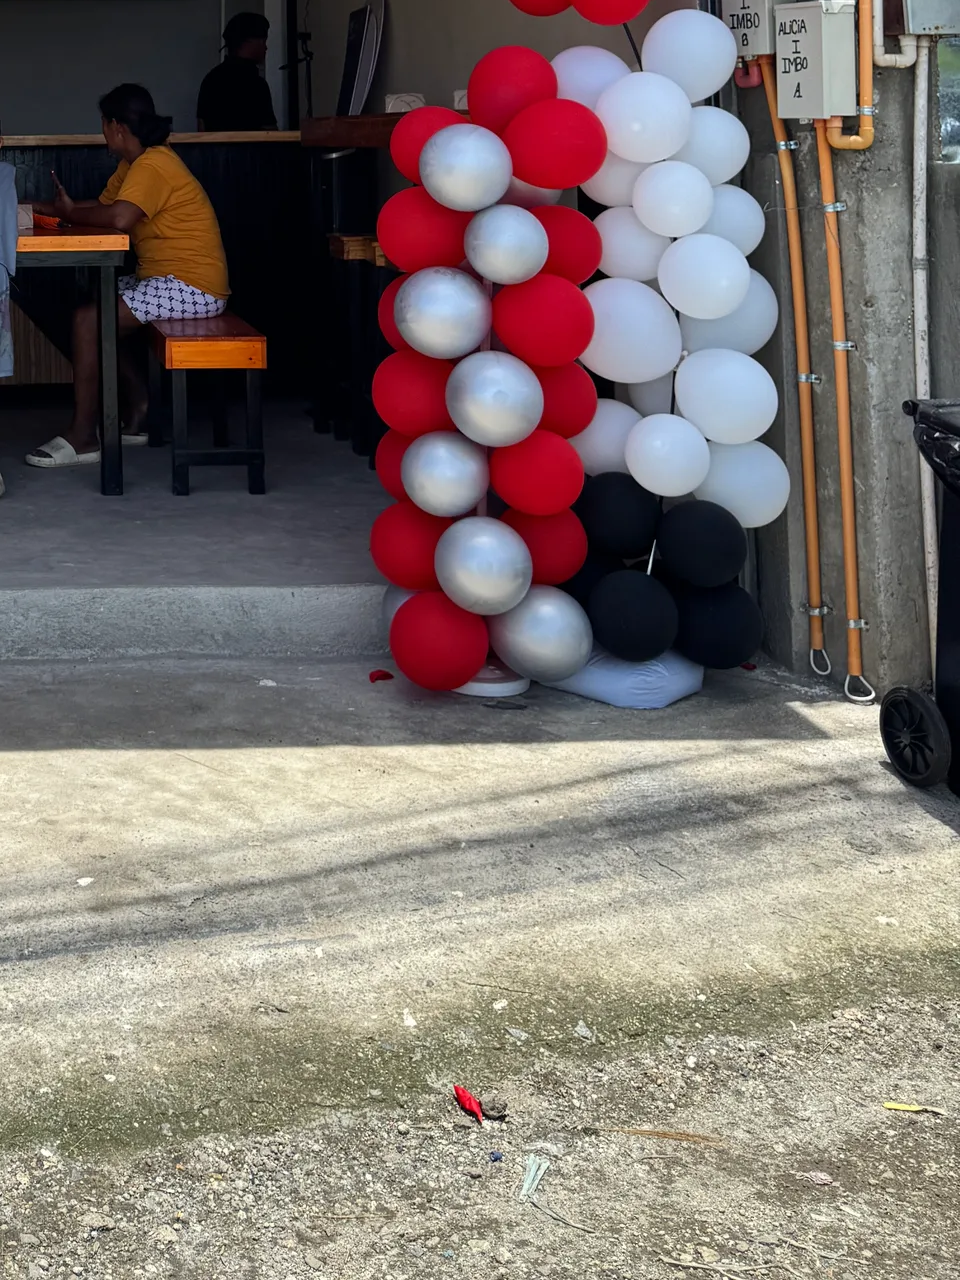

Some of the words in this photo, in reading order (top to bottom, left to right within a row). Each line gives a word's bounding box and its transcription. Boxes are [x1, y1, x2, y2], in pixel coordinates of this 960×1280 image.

[729, 12, 760, 29] IMBO
[792, 40, 801, 54] I
[781, 56, 808, 74] IMBO
[793, 82, 802, 98] A
